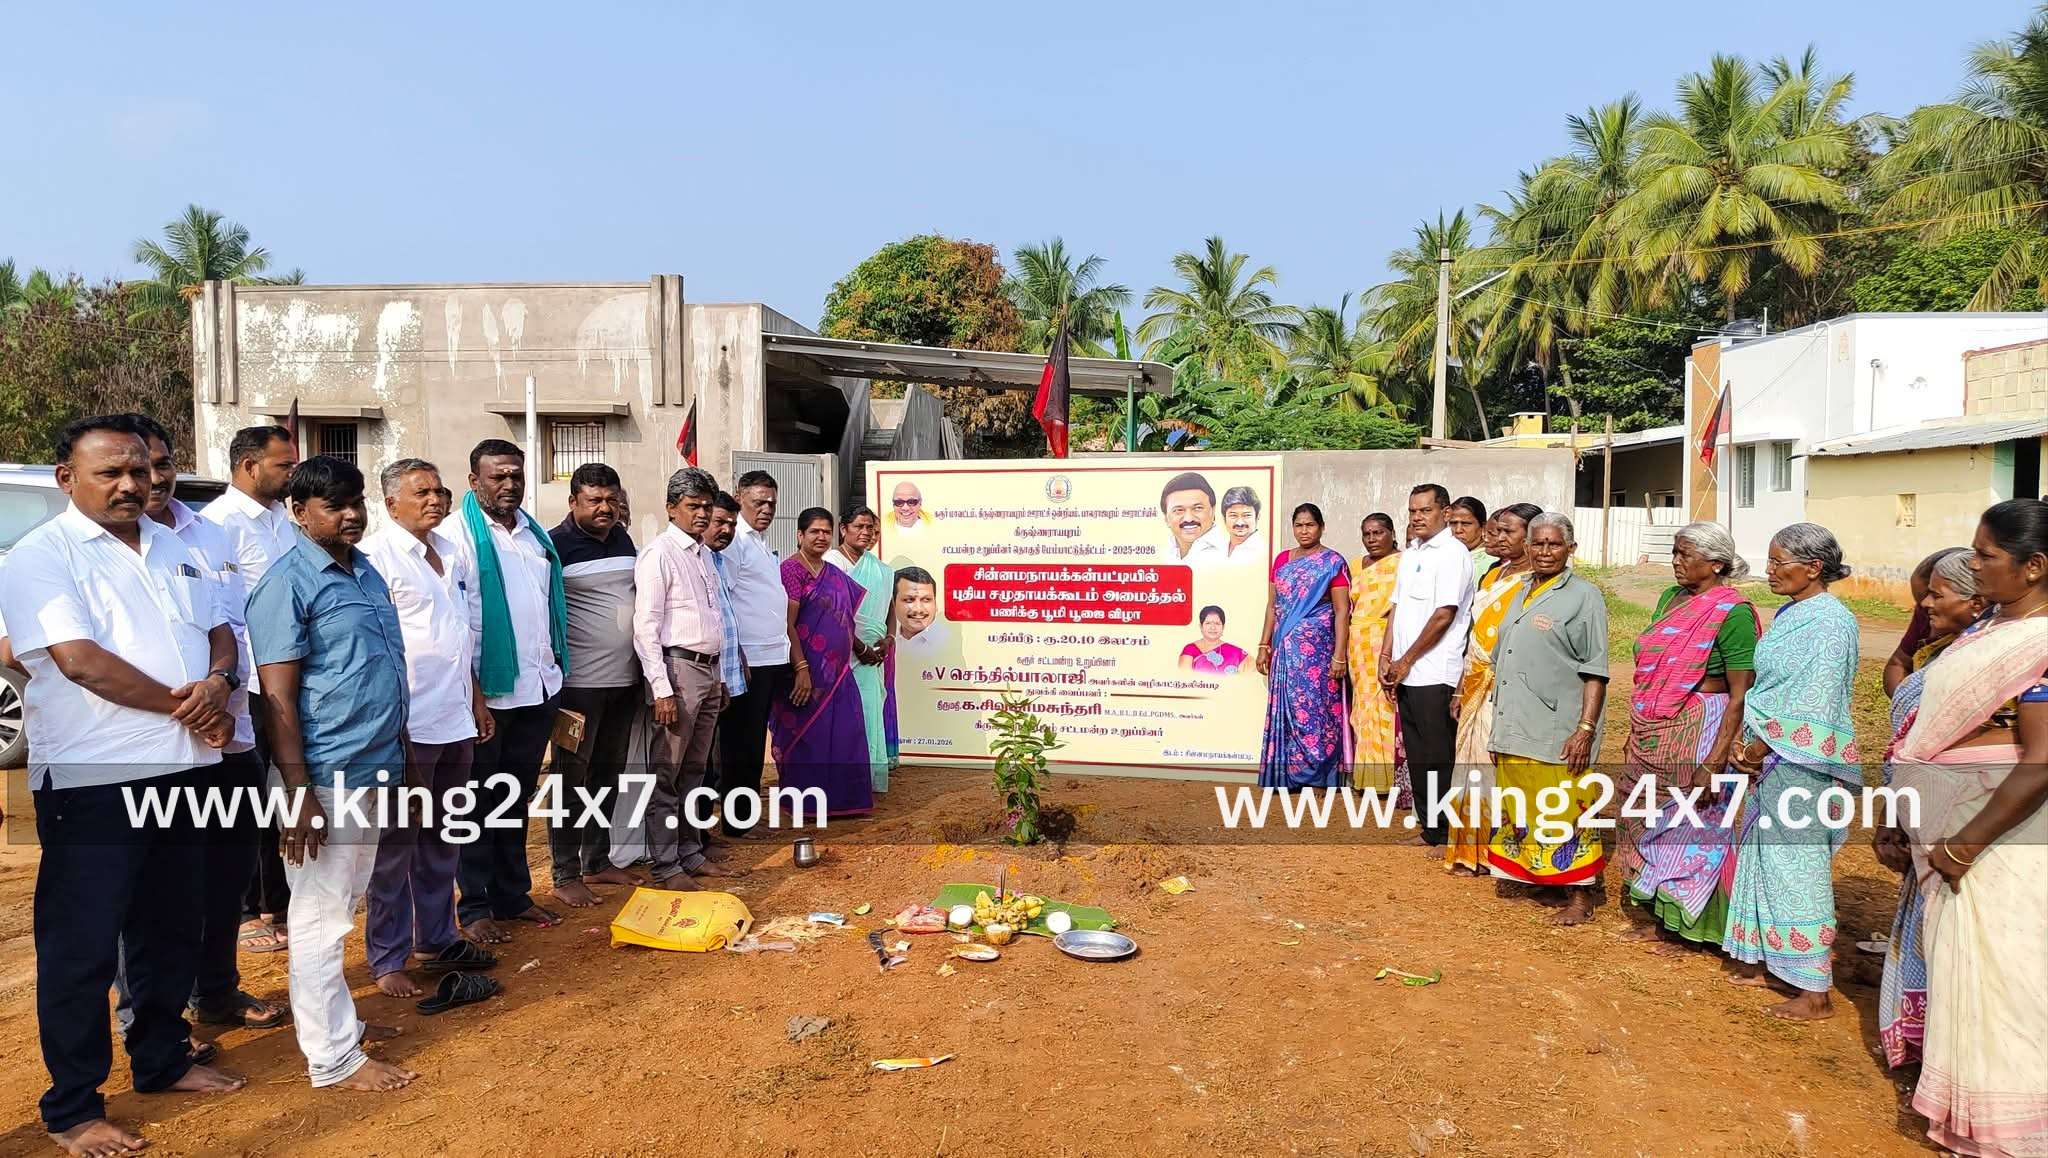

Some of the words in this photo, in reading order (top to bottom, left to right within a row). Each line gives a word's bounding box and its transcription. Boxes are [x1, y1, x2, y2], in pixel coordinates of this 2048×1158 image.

[1113, 545, 1156, 555] 2025-2026
[973, 566, 1159, 584] சின்னமநாயக்கன்பட்டியில்
[952, 586, 987, 602] புதிய
[989, 587, 1099, 603] சமுதாயக்கூடம்
[1103, 588, 1187, 605] அமைத்தல்
[990, 606, 1039, 619] பணிக்கு
[1042, 606, 1066, 620] பூமி
[1069, 609, 1105, 620] பூஜை
[1108, 607, 1142, 622] விழா
[987, 631, 1034, 645] மதிப்பீடு
[1098, 635, 1151, 646] இலட்சம்
[1037, 655, 1073, 668] சட்டமன்ற
[935, 666, 946, 680] V
[950, 665, 1087, 685] செந்தில்பாலாஜி
[917, 738, 953, 746] 27.01.2026
